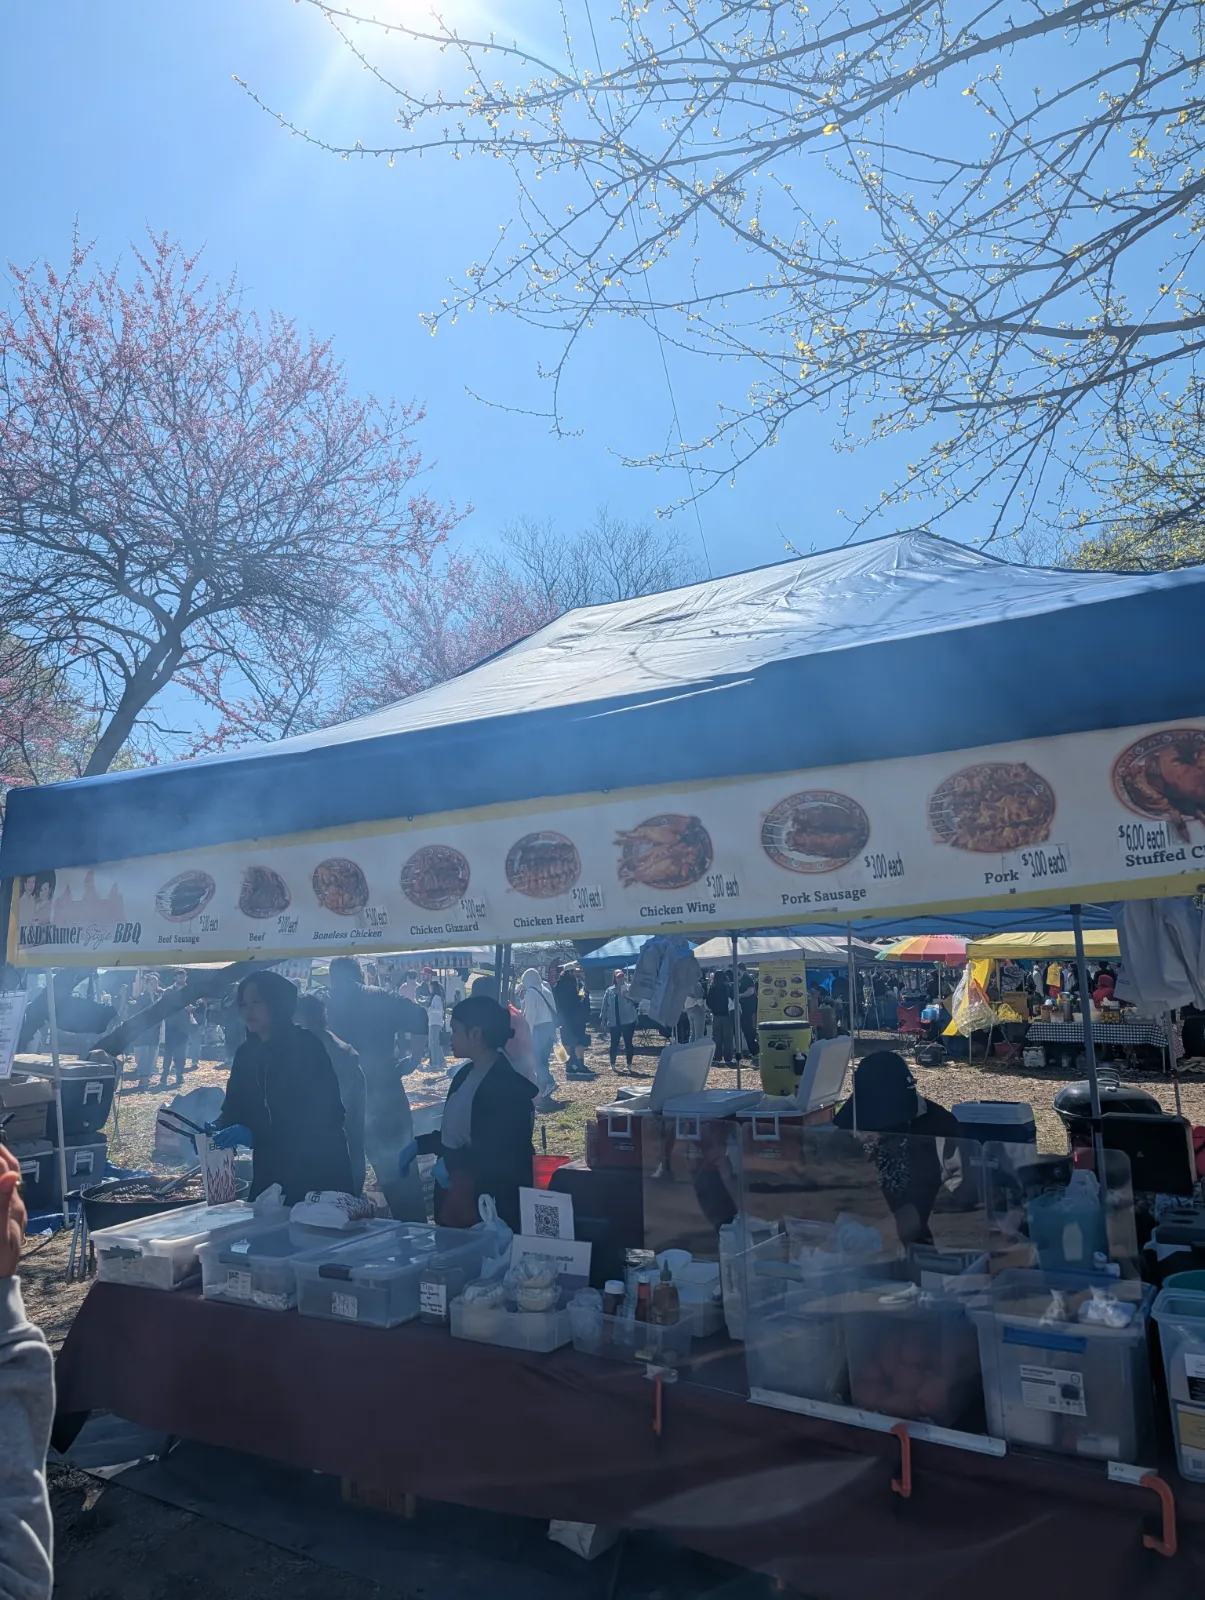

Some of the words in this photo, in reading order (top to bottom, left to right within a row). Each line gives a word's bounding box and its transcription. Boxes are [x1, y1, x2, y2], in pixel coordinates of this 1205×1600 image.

[1146, 822, 1166, 850] each
[1021, 850, 1048, 878] $3.00
[1048, 846, 1068, 875] each
[1125, 847, 1186, 867] Stuffed
[1191, 845, 1205, 859] C
[888, 851, 905, 878] each
[984, 869, 1020, 884] Pork
[781, 892, 811, 905] Pork
[814, 888, 867, 902] Sausage
[640, 904, 683, 917] Chicken
[686, 901, 716, 914] Wing
[410, 924, 443, 935] Chicken
[445, 922, 479, 934] Gizzard
[513, 916, 553, 928] Chicken
[556, 913, 585, 925] Heart
[45, 924, 83, 944] Khmer
[112, 922, 142, 945] BBQ
[158, 935, 173, 944] Beef
[173, 934, 200, 945] Sausage
[249, 932, 266, 942] Beef
[312, 931, 348, 940] Boneless
[350, 929, 382, 938] Chicken
